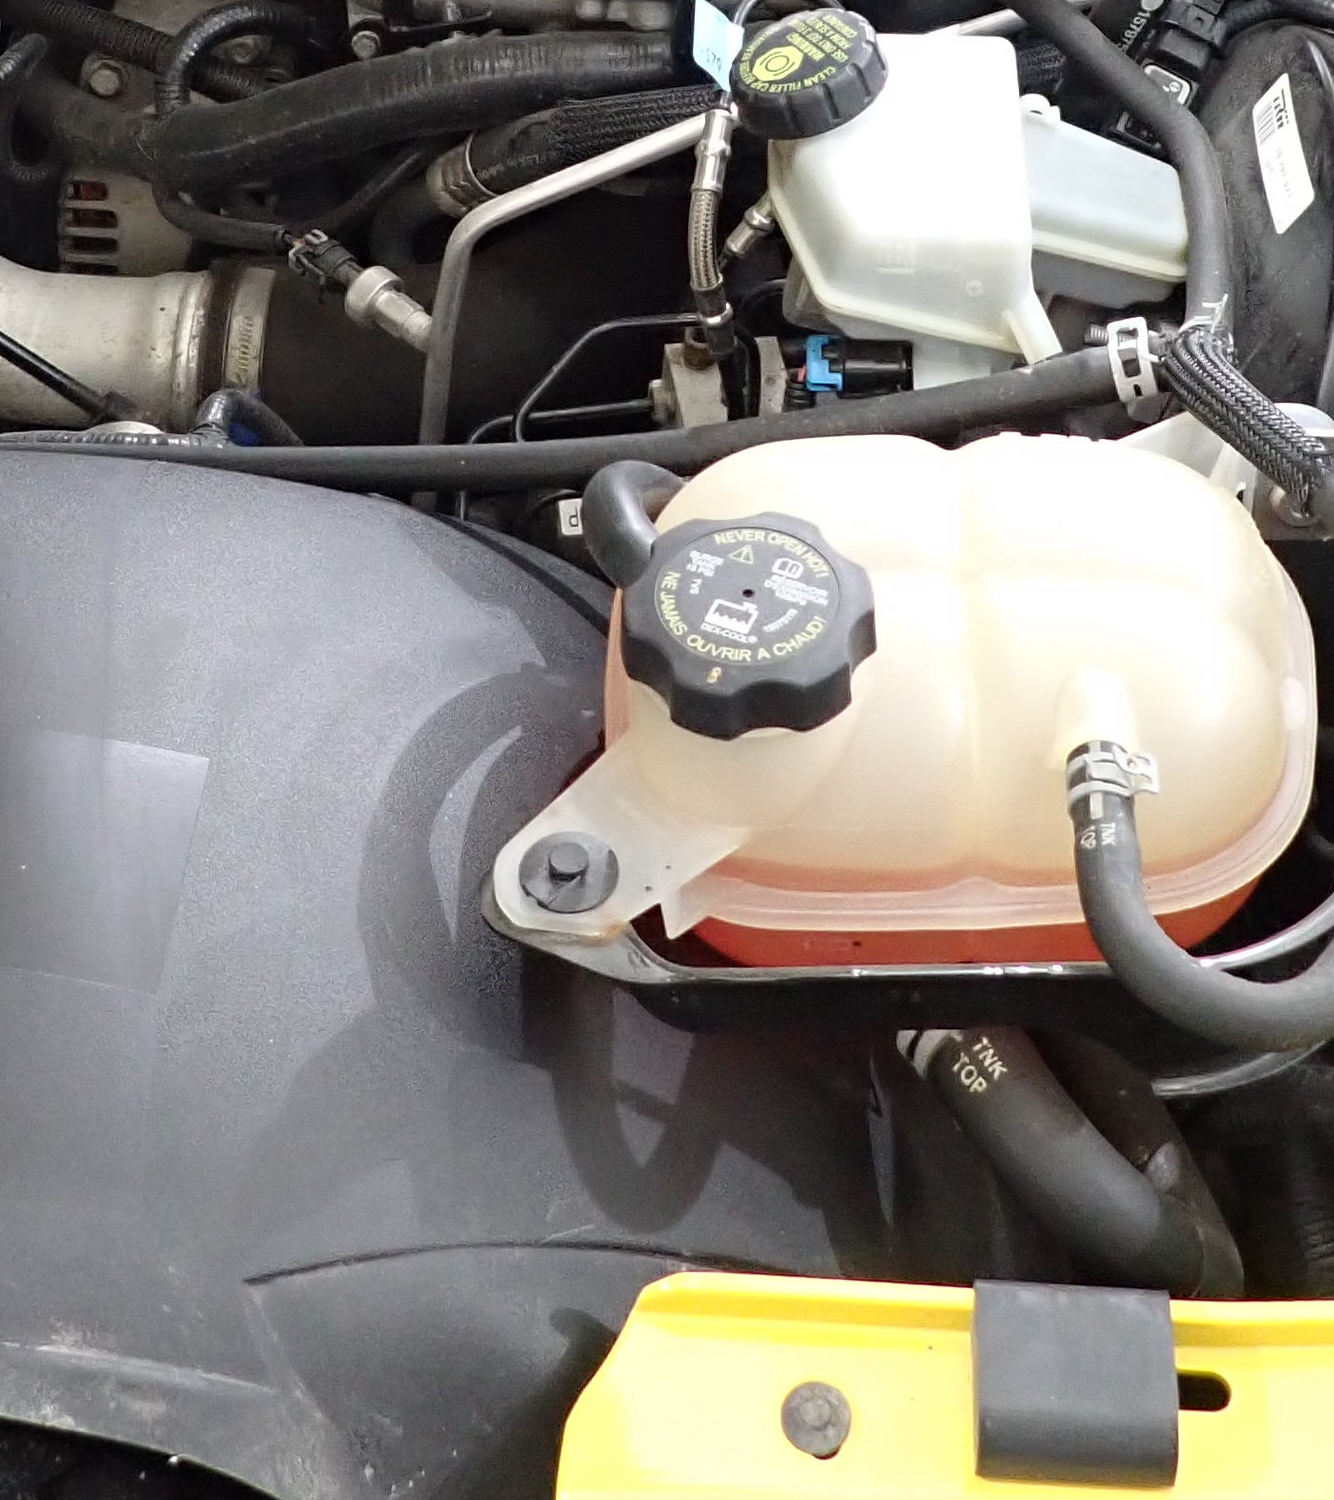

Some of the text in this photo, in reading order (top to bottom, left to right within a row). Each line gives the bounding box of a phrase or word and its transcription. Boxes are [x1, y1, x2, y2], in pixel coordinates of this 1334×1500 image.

[770, 80, 802, 92] FILLER
[804, 66, 836, 86] CLEAN
[714, 530, 766, 545] NEVER
[768, 532, 808, 556] OPEN
[661, 571, 681, 590] NE
[660, 592, 688, 635] JAMAIS
[772, 615, 827, 655] CHAUD!
[687, 635, 752, 662] OUVRIR
[757, 647, 771, 660] A
[1100, 822, 1116, 846] TNK
[972, 1036, 1008, 1081] TNK
[952, 1052, 987, 1094] TOP
